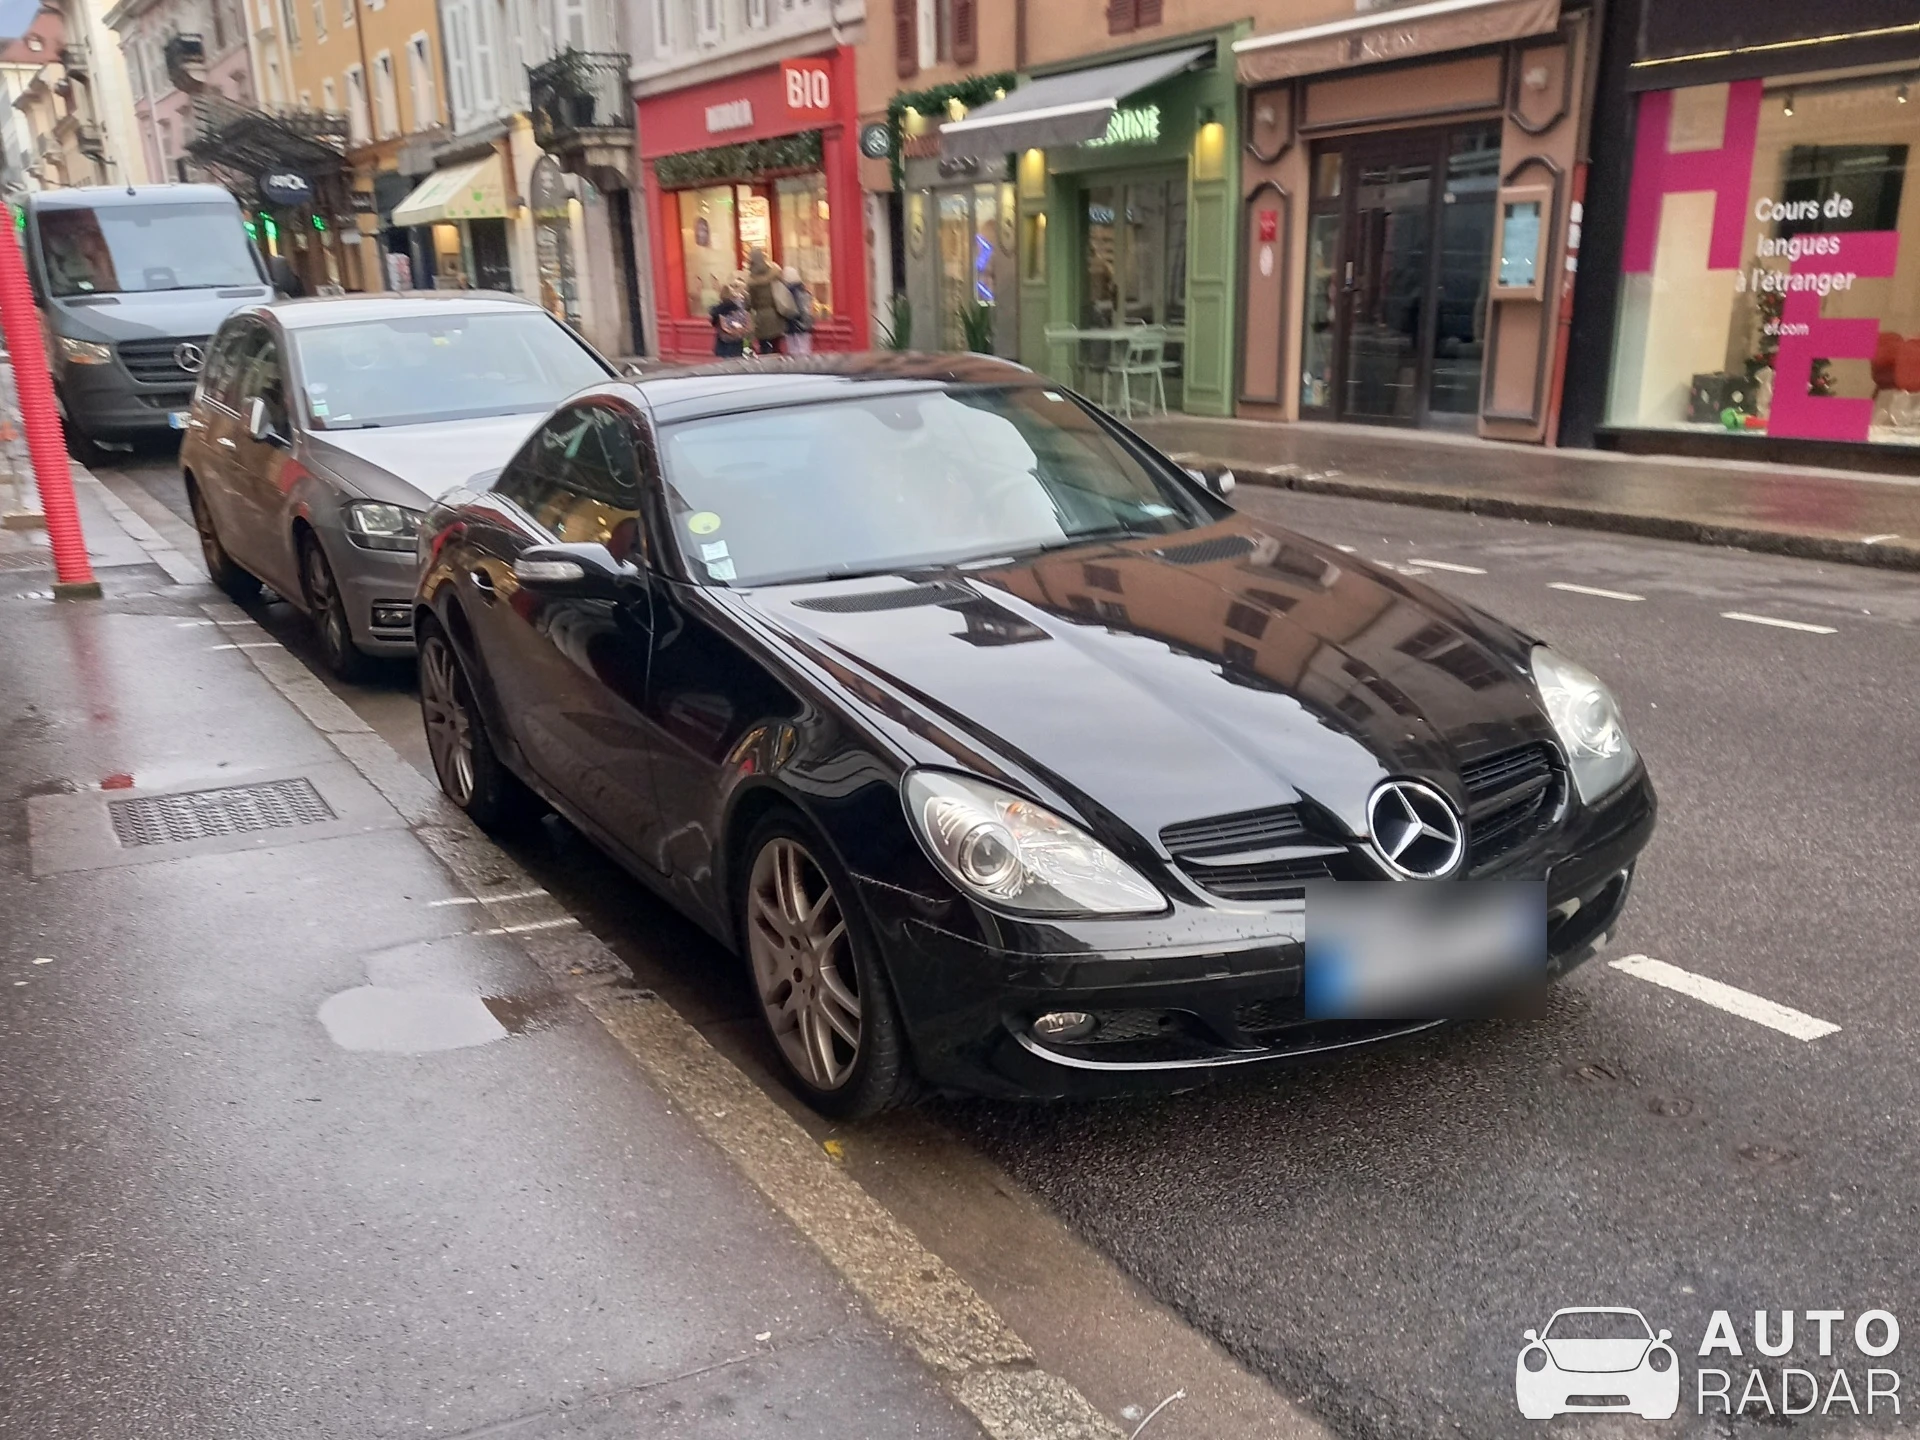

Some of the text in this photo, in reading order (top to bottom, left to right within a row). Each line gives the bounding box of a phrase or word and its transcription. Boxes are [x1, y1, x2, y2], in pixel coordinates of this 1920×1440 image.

[785, 68, 831, 109] BIO
[1755, 192, 1854, 222] Cours de
[1756, 233, 1841, 262] langues
[1735, 267, 1857, 297] à l'étranger
[1763, 321, 1810, 336] ef.com
